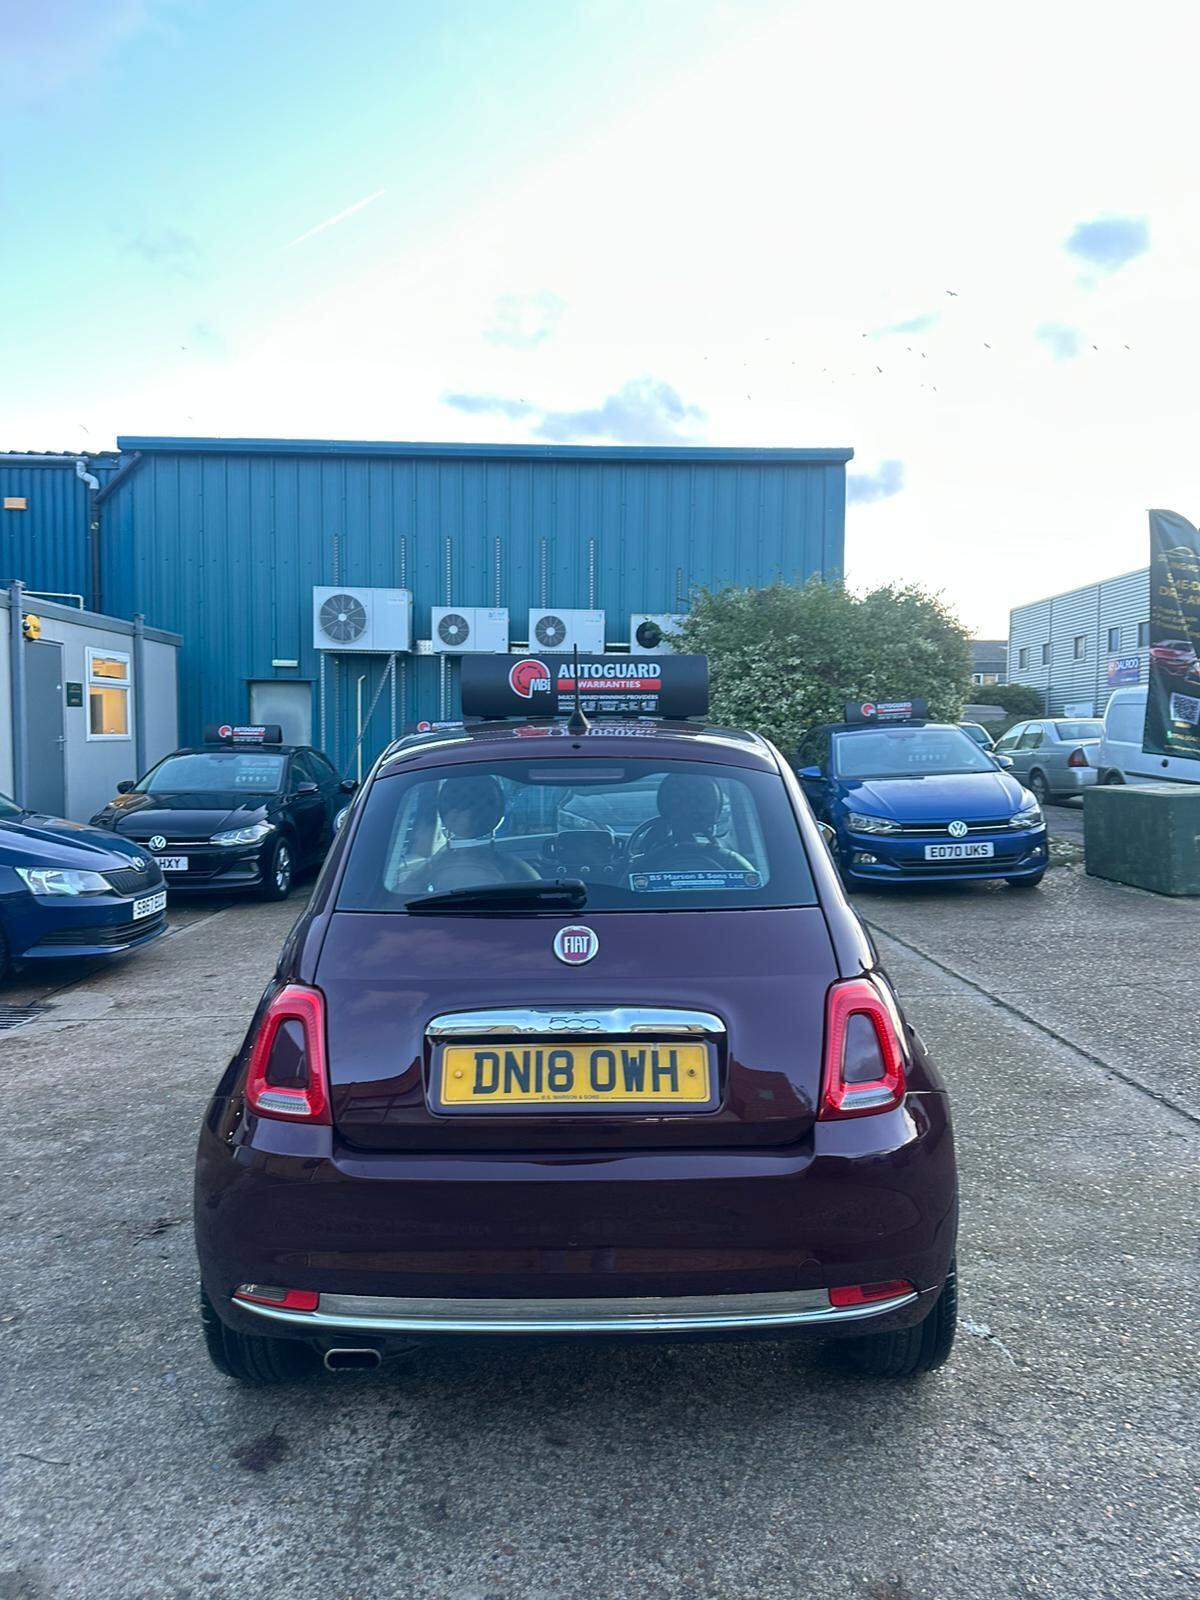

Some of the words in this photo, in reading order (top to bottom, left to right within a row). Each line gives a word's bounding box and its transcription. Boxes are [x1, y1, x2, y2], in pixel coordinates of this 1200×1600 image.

[558, 664, 661, 678] AUTOGUARD
[578, 680, 641, 688] WARRANTIES
[965, 844, 989, 856] UKS
[563, 936, 590, 954] FIAT
[549, 1016, 601, 1031] 500
[473, 1050, 574, 1094] DN18
[589, 1049, 679, 1092] OWH
